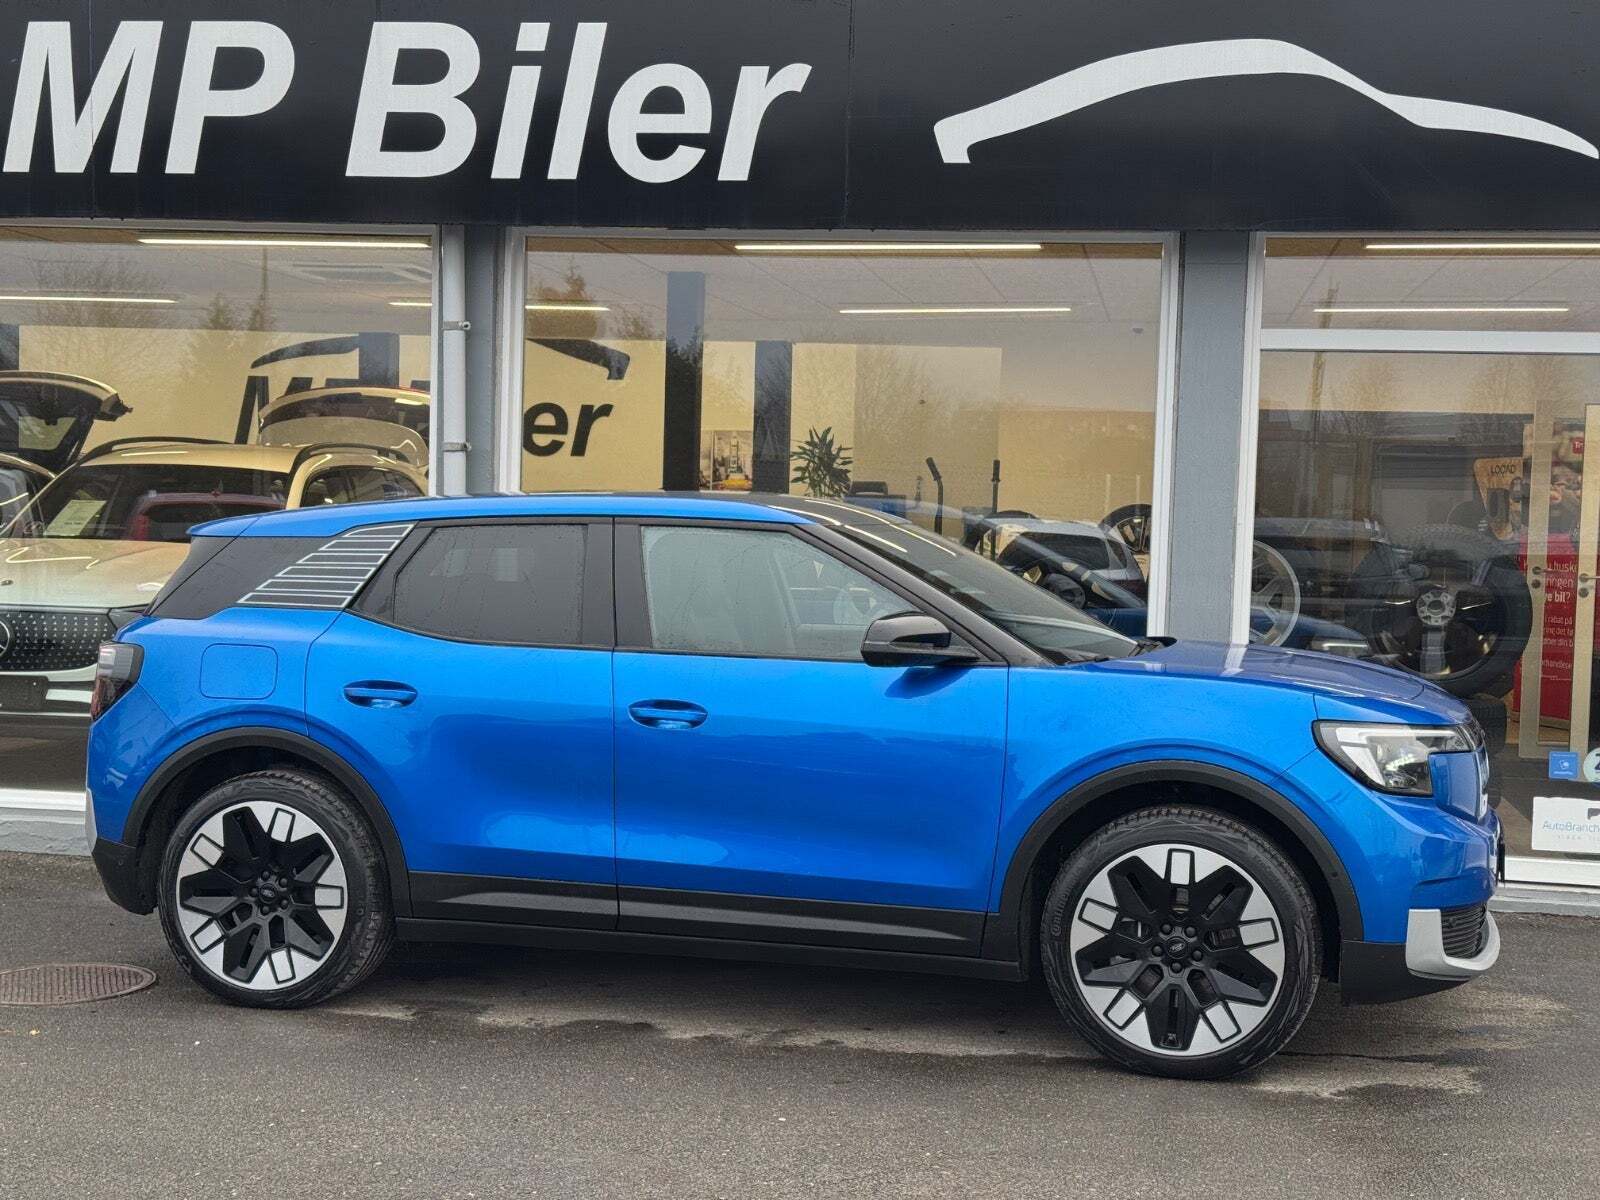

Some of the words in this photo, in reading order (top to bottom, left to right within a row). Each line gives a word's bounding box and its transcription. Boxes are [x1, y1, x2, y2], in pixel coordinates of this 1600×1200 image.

[3, 20, 296, 175] MP
[345, 21, 813, 184] Biler
[1542, 820, 1600, 833] AutoBranch
